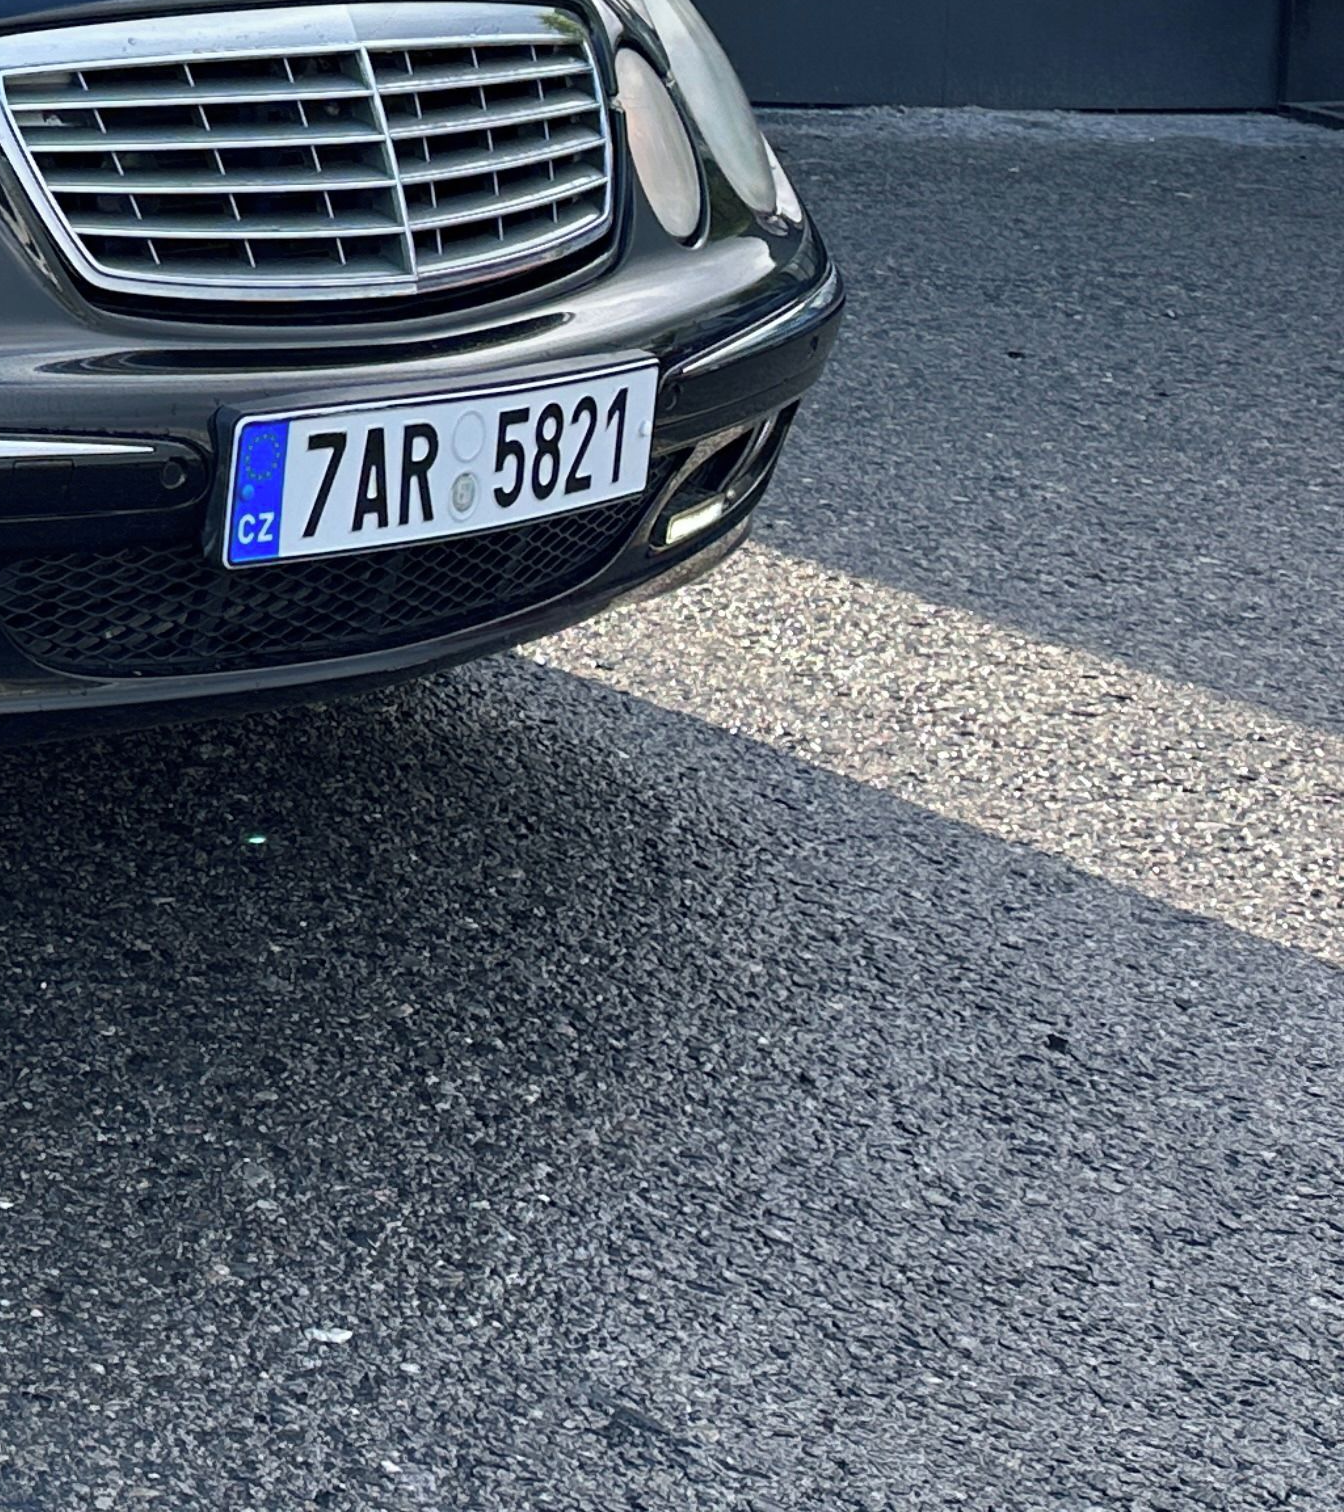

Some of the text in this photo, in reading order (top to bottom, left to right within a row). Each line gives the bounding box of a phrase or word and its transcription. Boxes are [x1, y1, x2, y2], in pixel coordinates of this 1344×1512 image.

[301, 387, 629, 538] 7AR 5821
[238, 513, 273, 544] CZ
